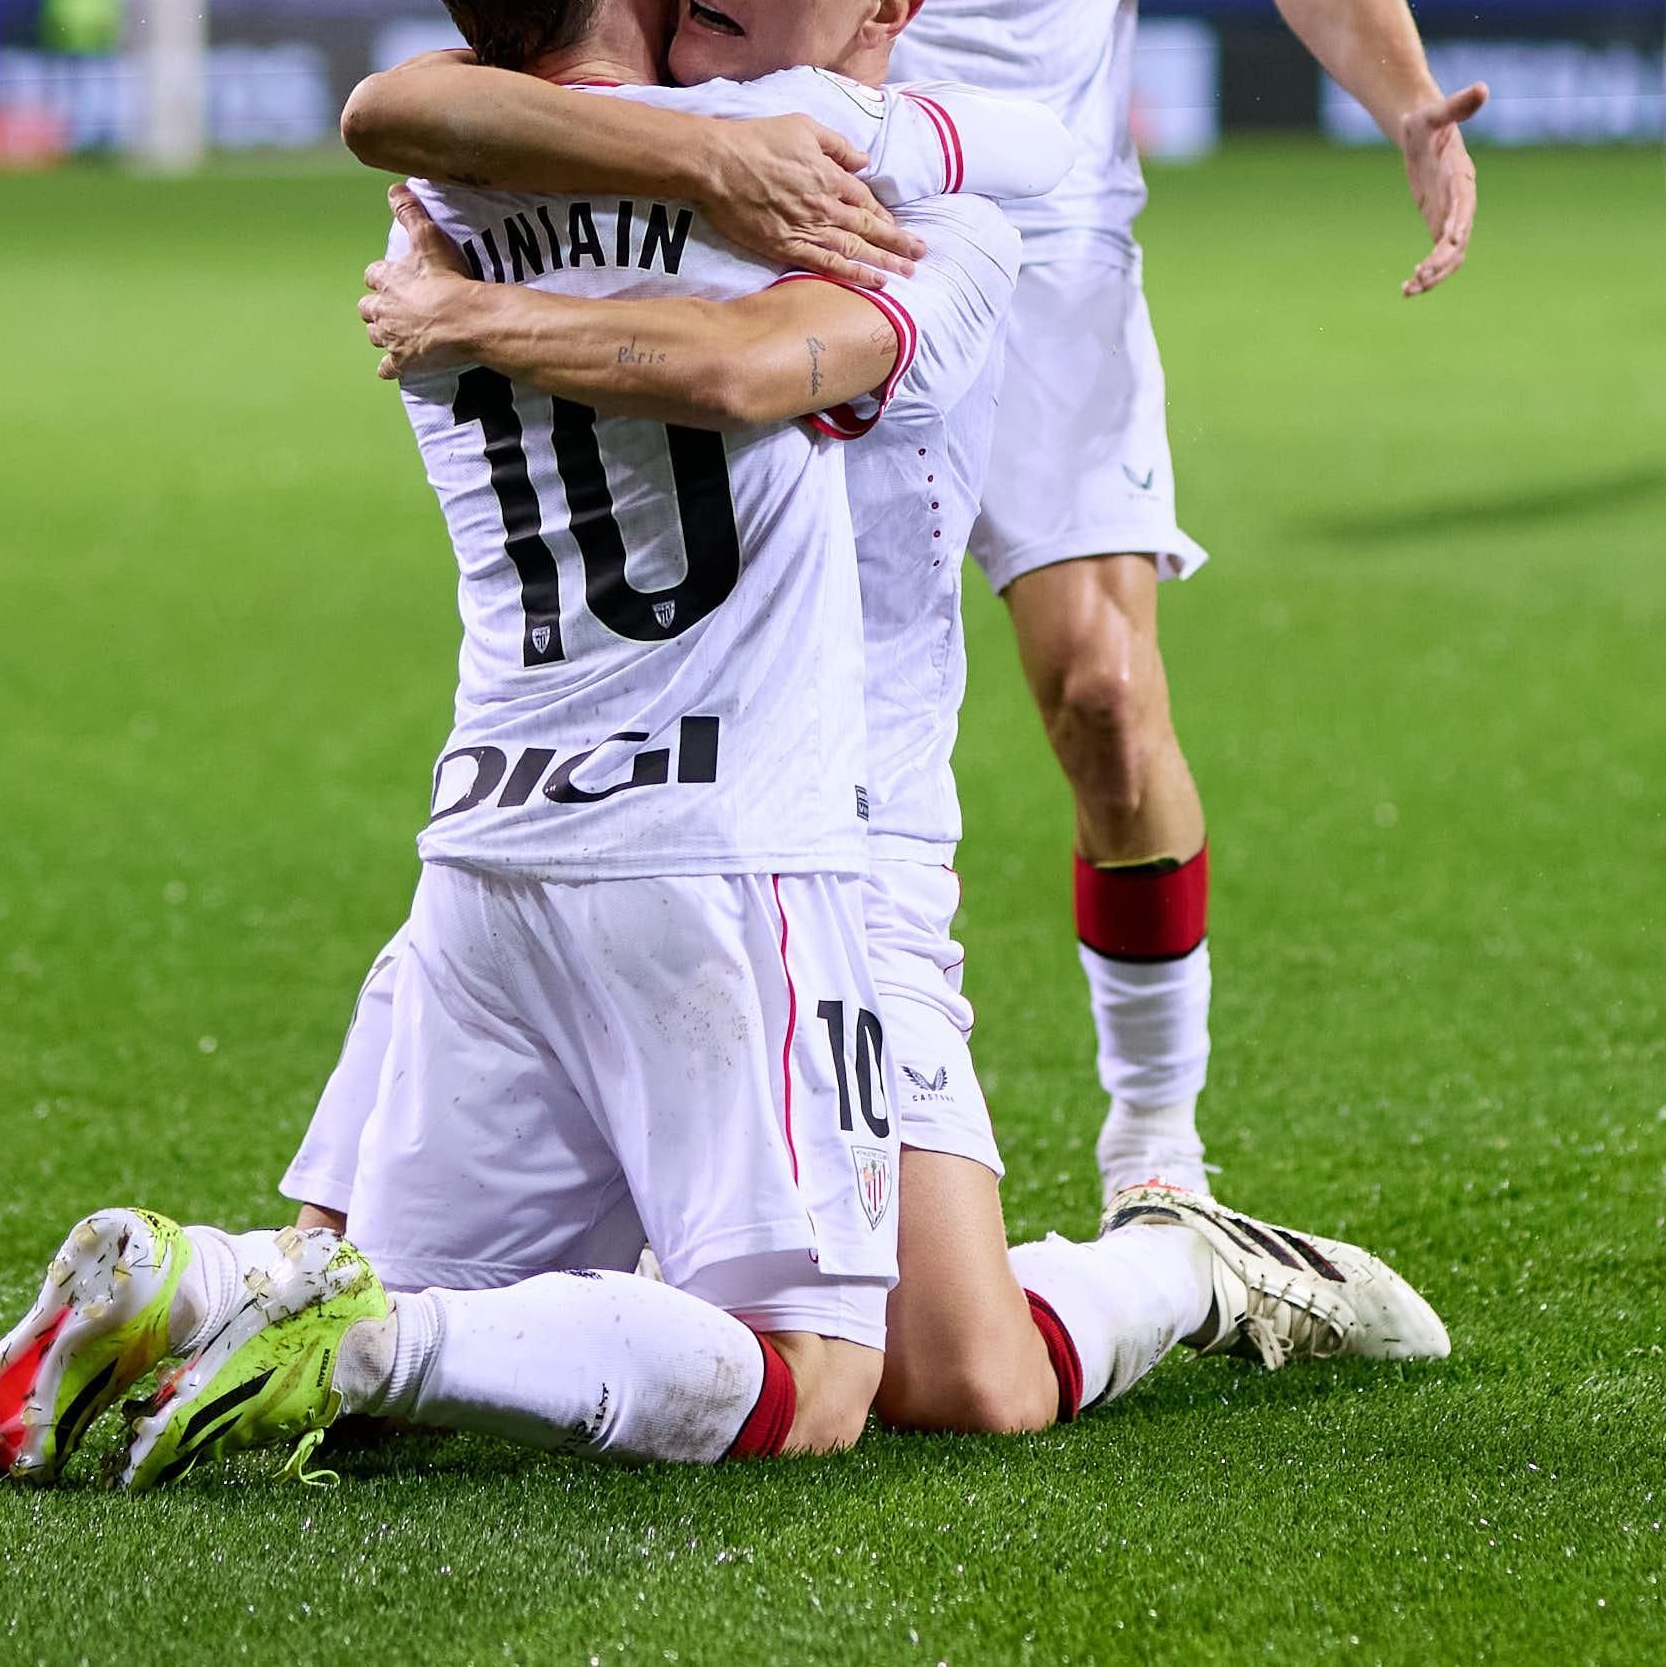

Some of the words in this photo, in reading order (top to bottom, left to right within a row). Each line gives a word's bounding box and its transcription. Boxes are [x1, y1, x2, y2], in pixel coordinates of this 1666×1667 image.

[463, 200, 693, 284] UNIAIN
[452, 366, 740, 667] 10
[430, 716, 720, 821] DIGI
[817, 1000, 890, 1138] 10
